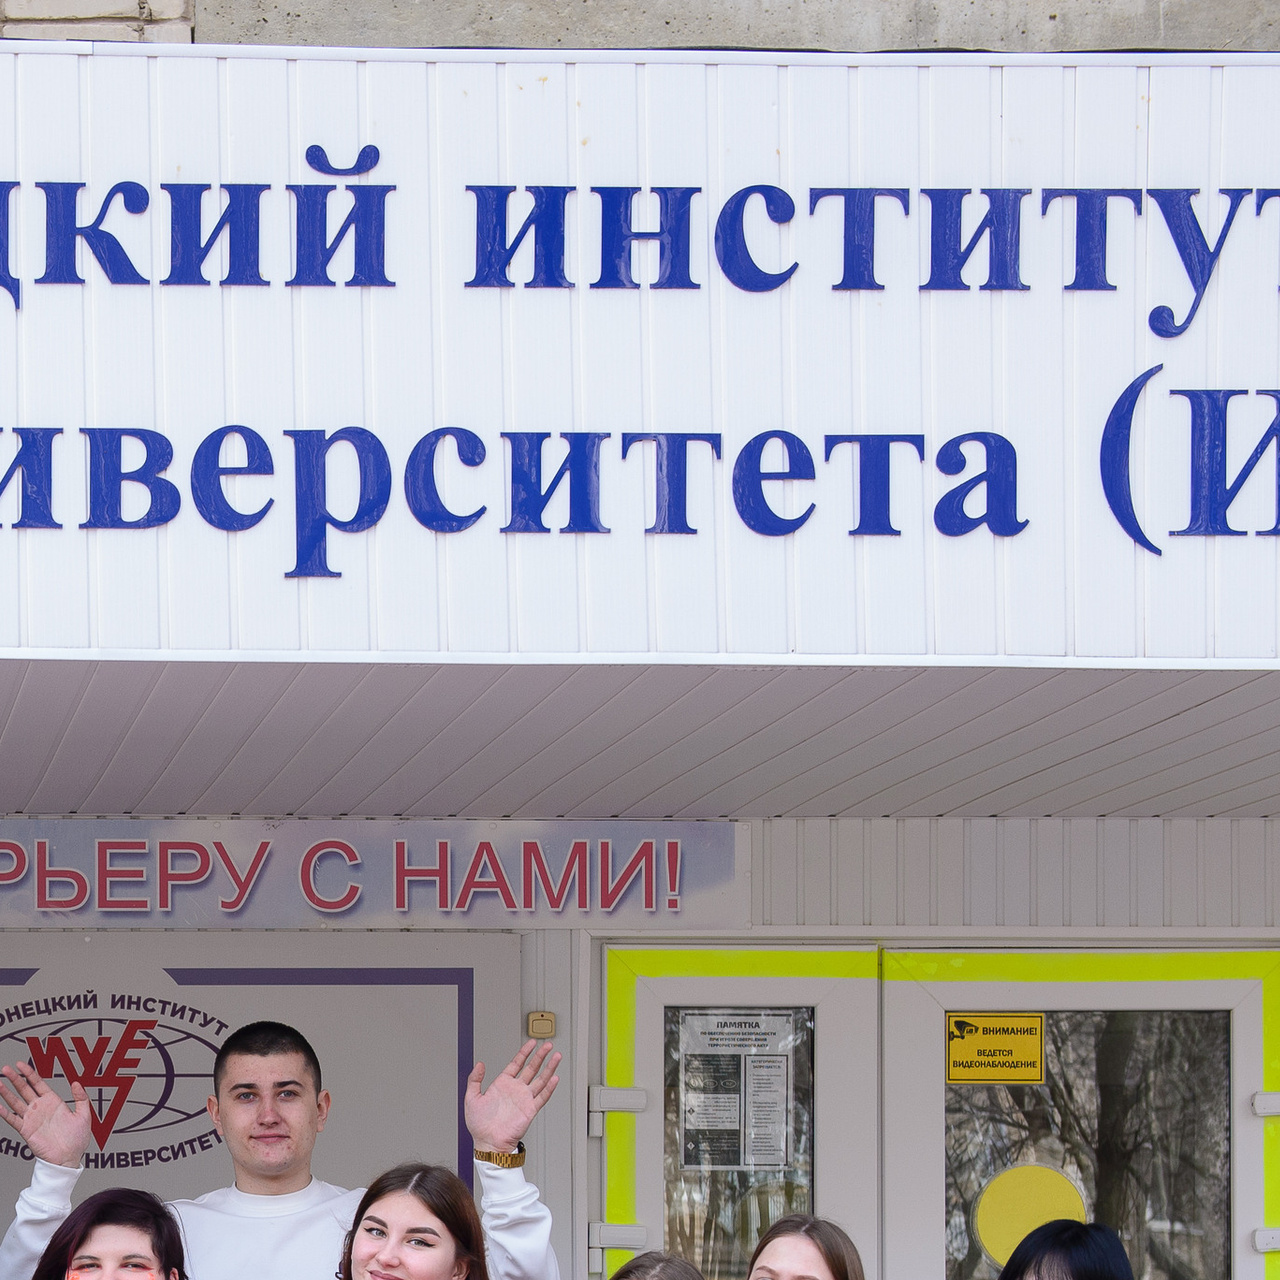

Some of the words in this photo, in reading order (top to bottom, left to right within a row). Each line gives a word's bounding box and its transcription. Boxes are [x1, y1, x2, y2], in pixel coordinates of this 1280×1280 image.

[465, 185, 1280, 338] институ
[301, 839, 360, 909] С
[395, 840, 679, 908] НАМИ!
[110, 994, 229, 1036] ИНСТИТУТ
[716, 1021, 760, 1029] ПАМЯТКА
[982, 1027, 1038, 1035] ВНИМАНИЕ!
[977, 1049, 1013, 1058] ВЕДЕТСЯ
[952, 1060, 1038, 1069] ВИДЕОНАБЛЮДЕНИЕ
